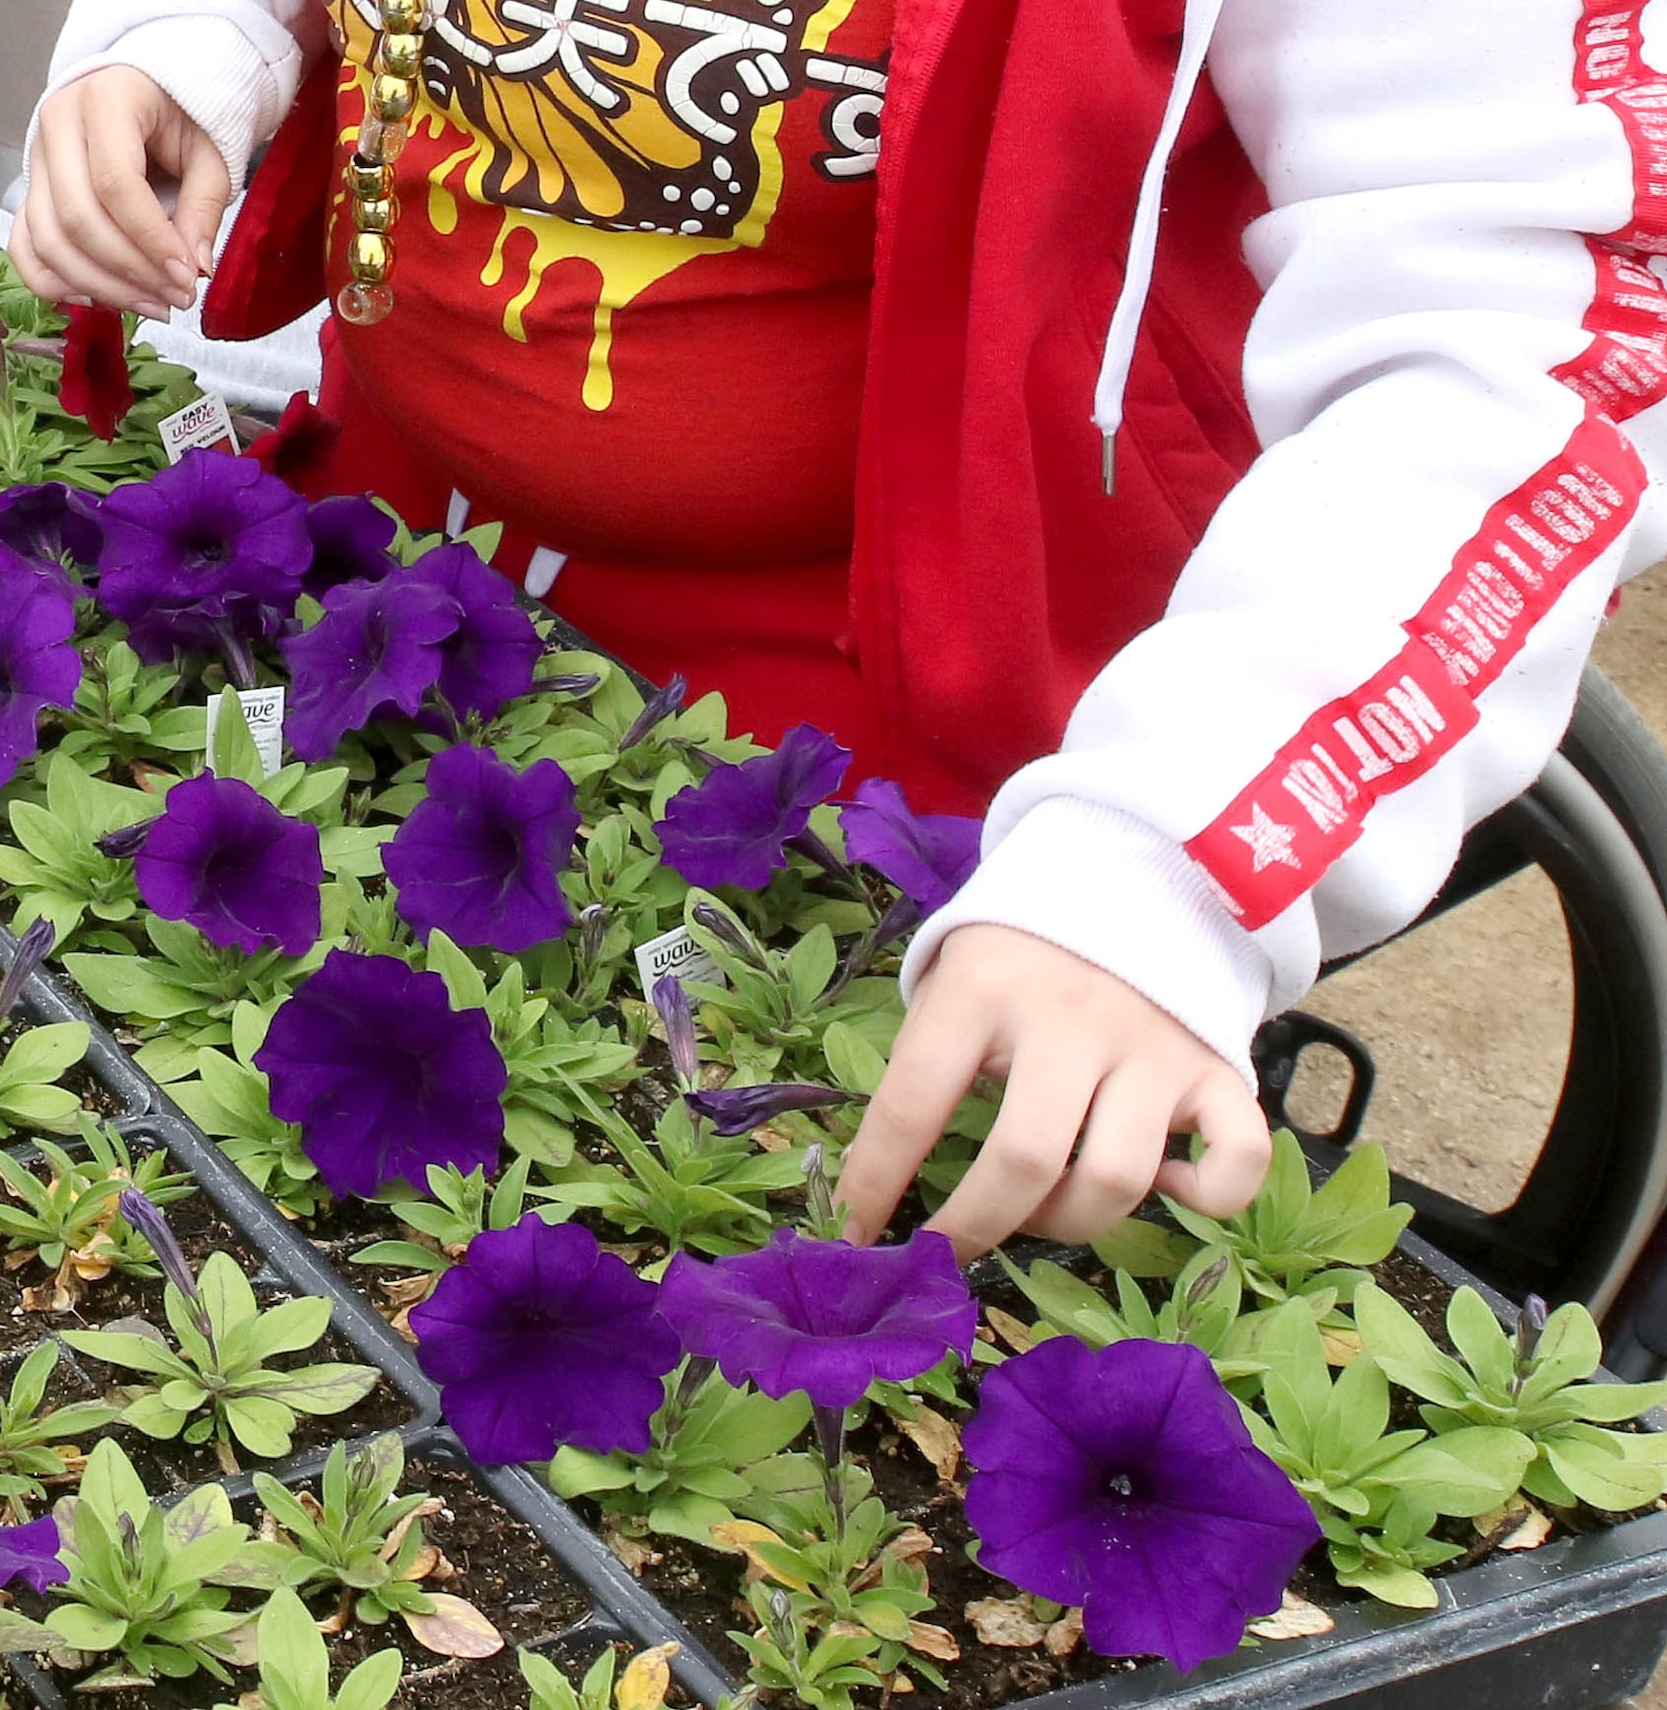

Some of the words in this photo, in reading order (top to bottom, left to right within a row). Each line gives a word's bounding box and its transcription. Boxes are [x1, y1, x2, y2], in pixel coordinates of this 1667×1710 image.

[172, 407, 215, 438] wave
[181, 402, 208, 421] EASY
[197, 425, 226, 444] VELOUR
[1506, 463, 1624, 571] NOT
[243, 702, 275, 718] ave
[1334, 674, 1448, 782] NOT
